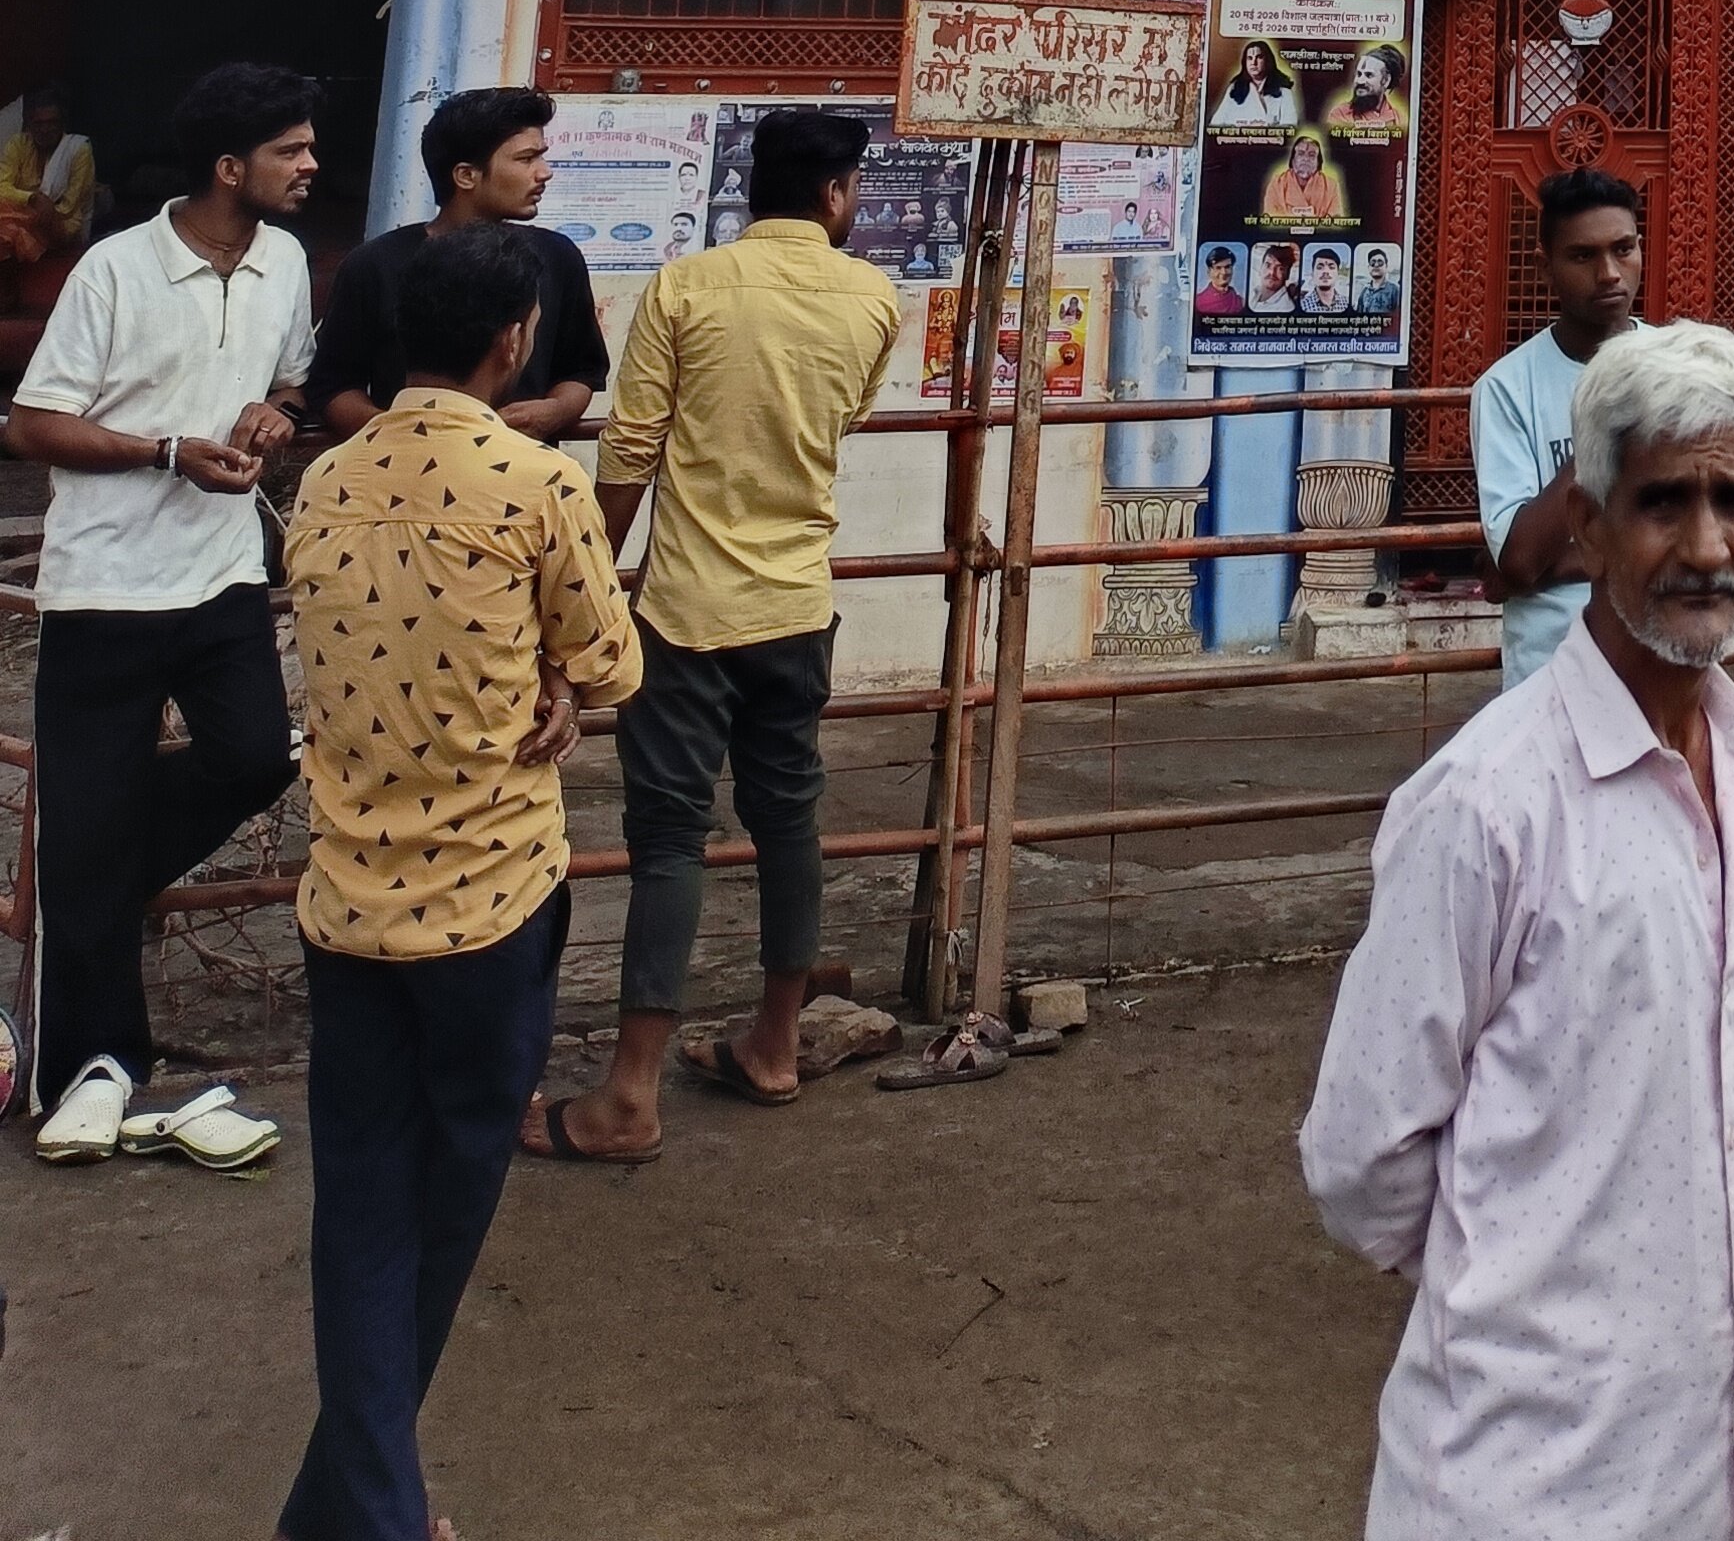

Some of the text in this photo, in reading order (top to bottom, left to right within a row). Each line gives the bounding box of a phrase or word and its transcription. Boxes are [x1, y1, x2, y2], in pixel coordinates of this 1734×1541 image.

[1243, 9, 1254, 19] मई
[1257, 11, 1279, 19] 2026
[1282, 10, 1307, 21] विशाल
[1239, 23, 1250, 32] 26
[1252, 23, 1263, 32] मई
[1266, 24, 1288, 32] 2026
[916, 52, 972, 109] कोई
[1229, 342, 1256, 352] समस्त
[1311, 342, 1338, 352] समस्त
[1365, 342, 1397, 352] यजमान
